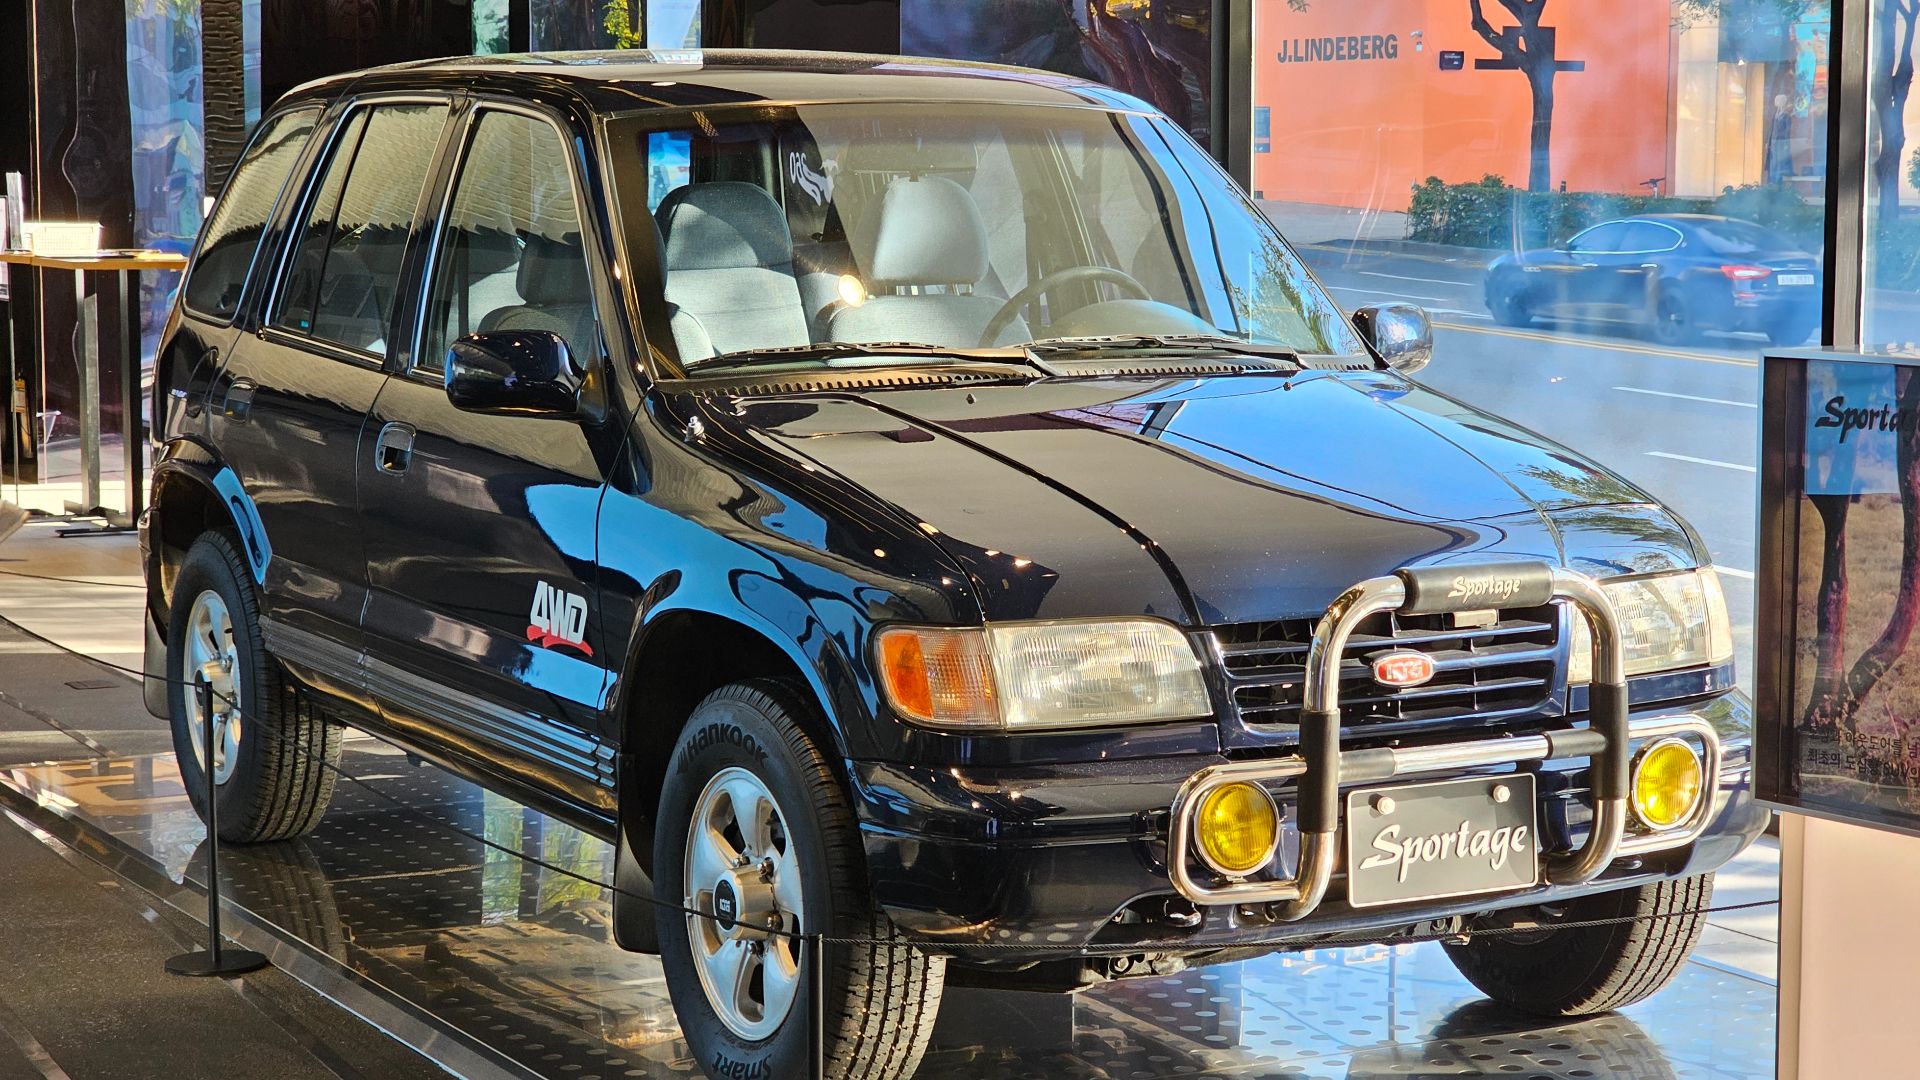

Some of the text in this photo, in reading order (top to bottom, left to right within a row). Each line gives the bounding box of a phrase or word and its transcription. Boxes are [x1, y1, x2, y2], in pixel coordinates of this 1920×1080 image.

[1277, 34, 1398, 63] J.LINDEBERG
[1815, 396, 1920, 444] Sporta
[1447, 575, 1522, 604] Sportage
[530, 580, 588, 644] 4WD
[1807, 748, 1840, 768] 최초의
[1845, 731, 1902, 757] 아웃도어를
[1359, 820, 1527, 883] Sportage
